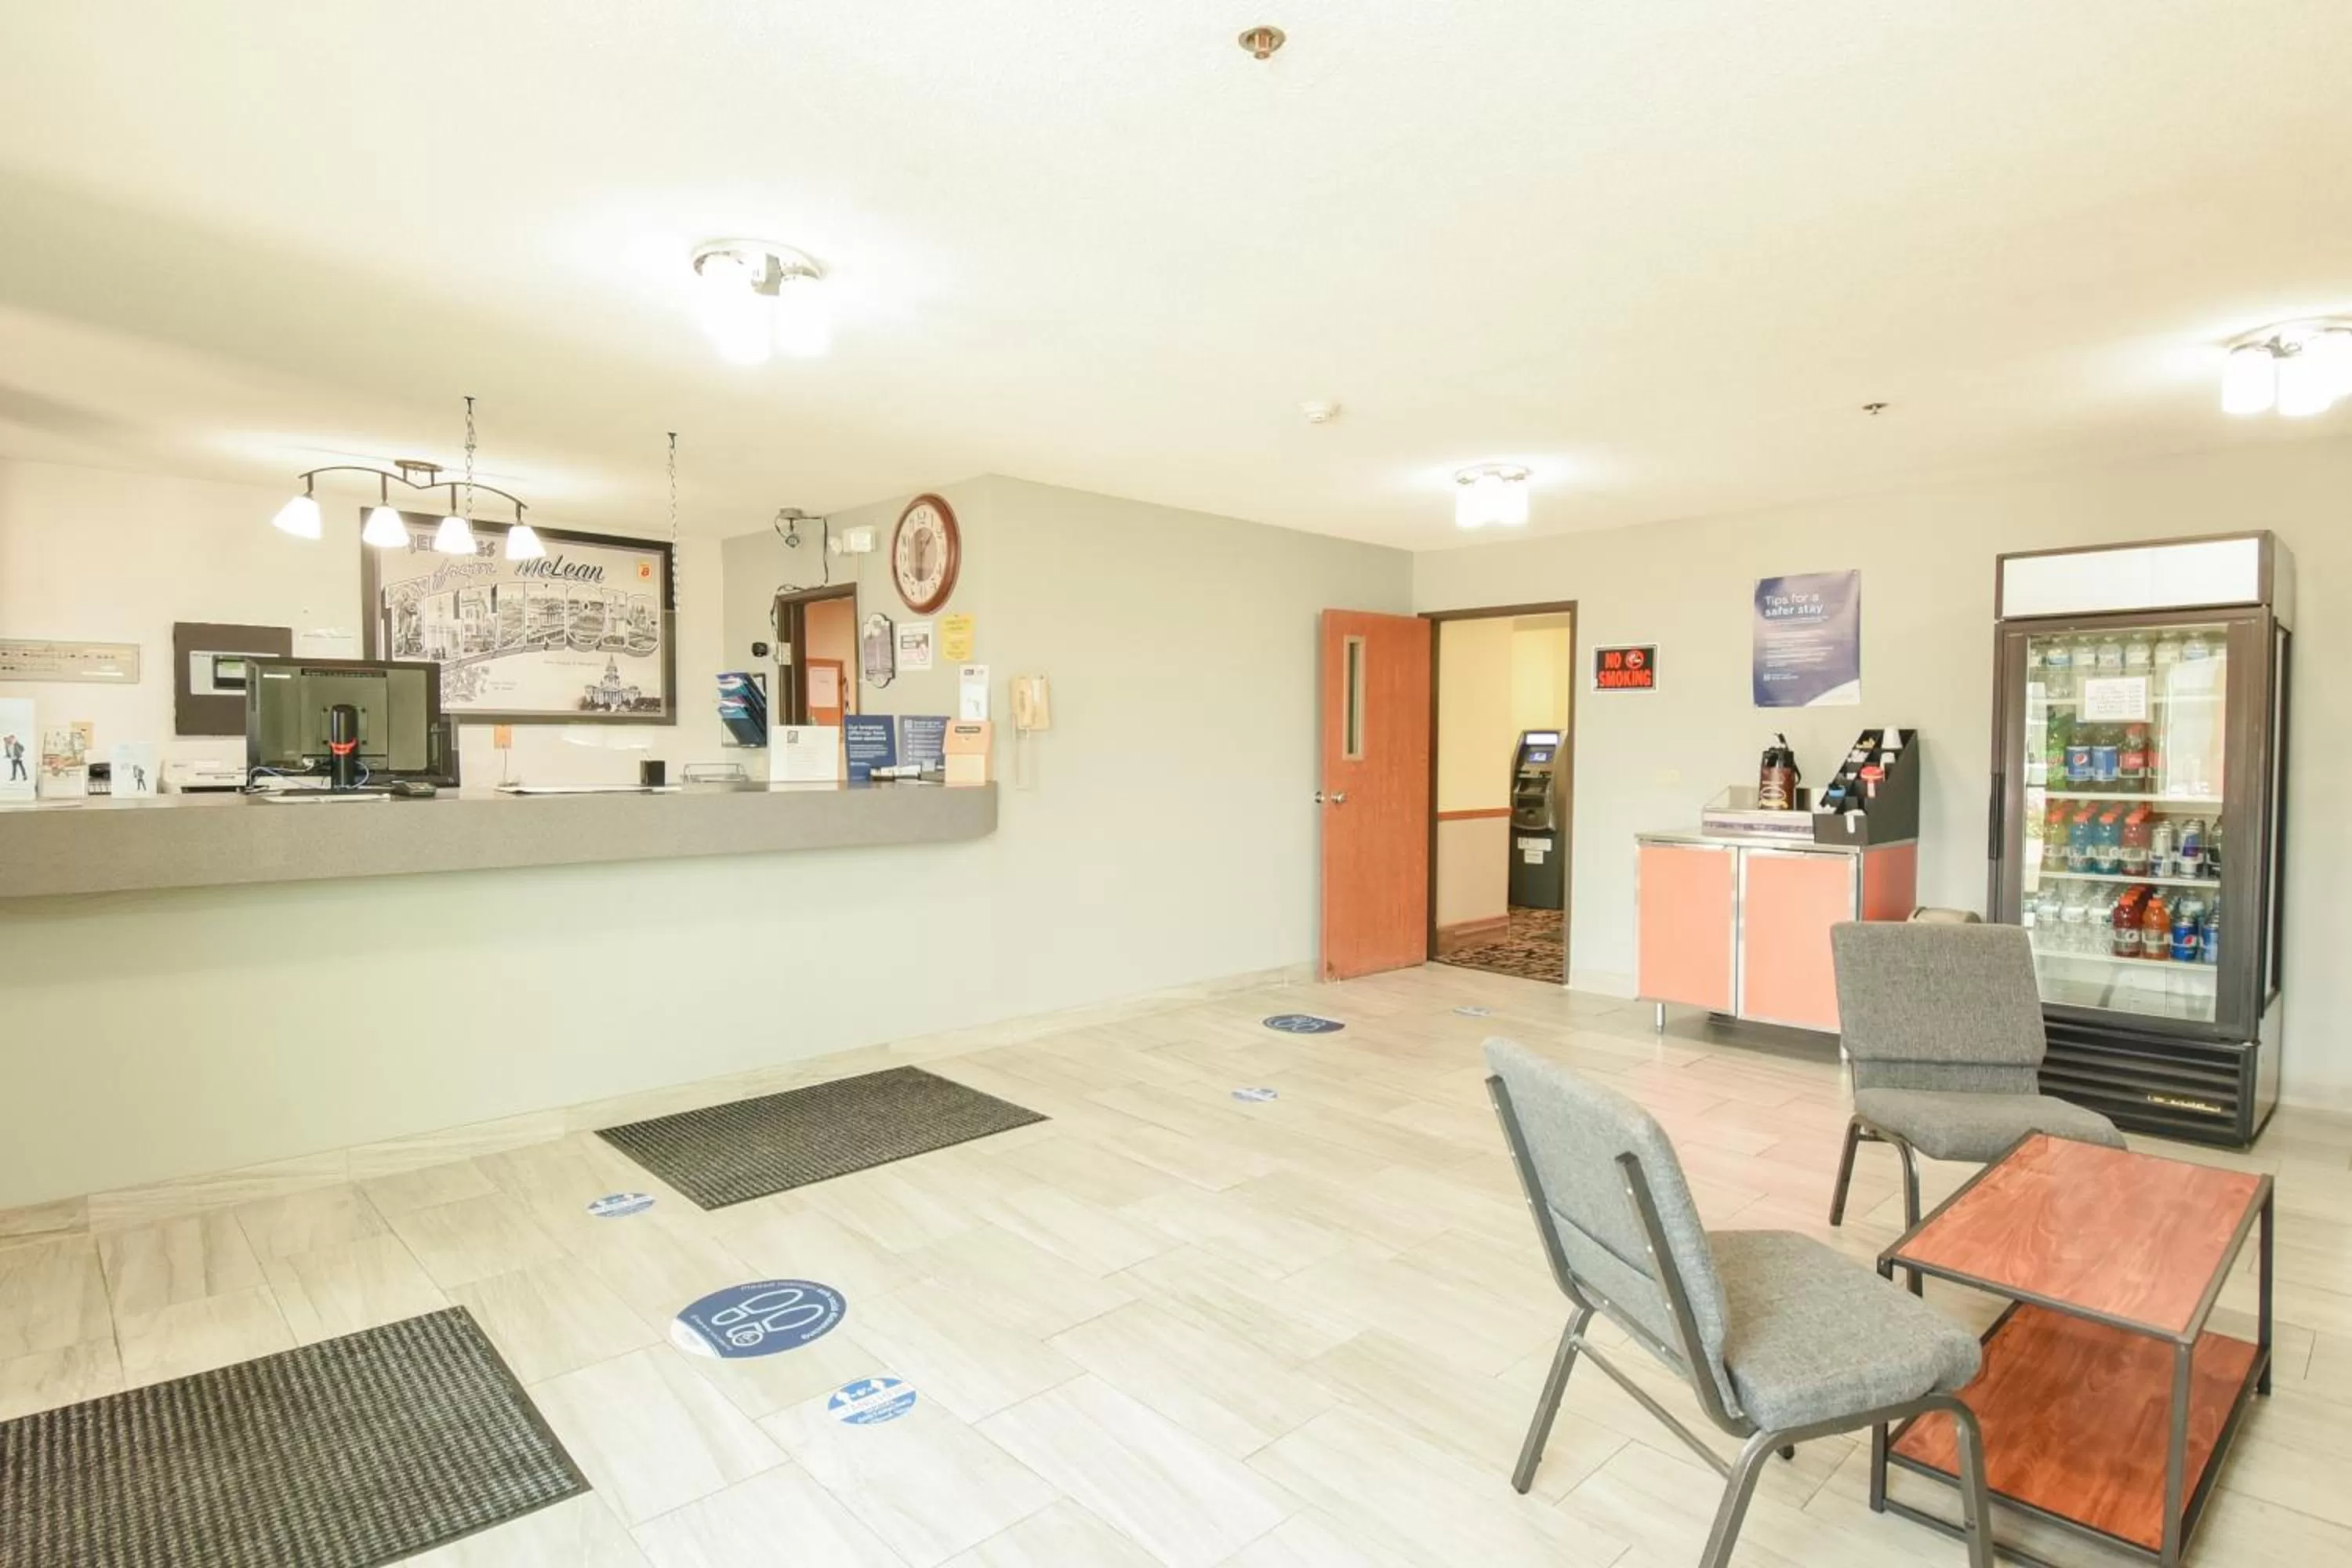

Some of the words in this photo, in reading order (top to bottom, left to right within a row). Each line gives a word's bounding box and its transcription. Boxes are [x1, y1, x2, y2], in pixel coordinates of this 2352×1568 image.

[513, 554, 605, 583] McLean
[1764, 594, 1789, 608] Tips
[1791, 593, 1809, 604] for
[1765, 605, 1795, 617] safer
[1797, 604, 1824, 615] stay
[1605, 652, 1622, 669] NO
[1598, 669, 1651, 688] SMOKING
